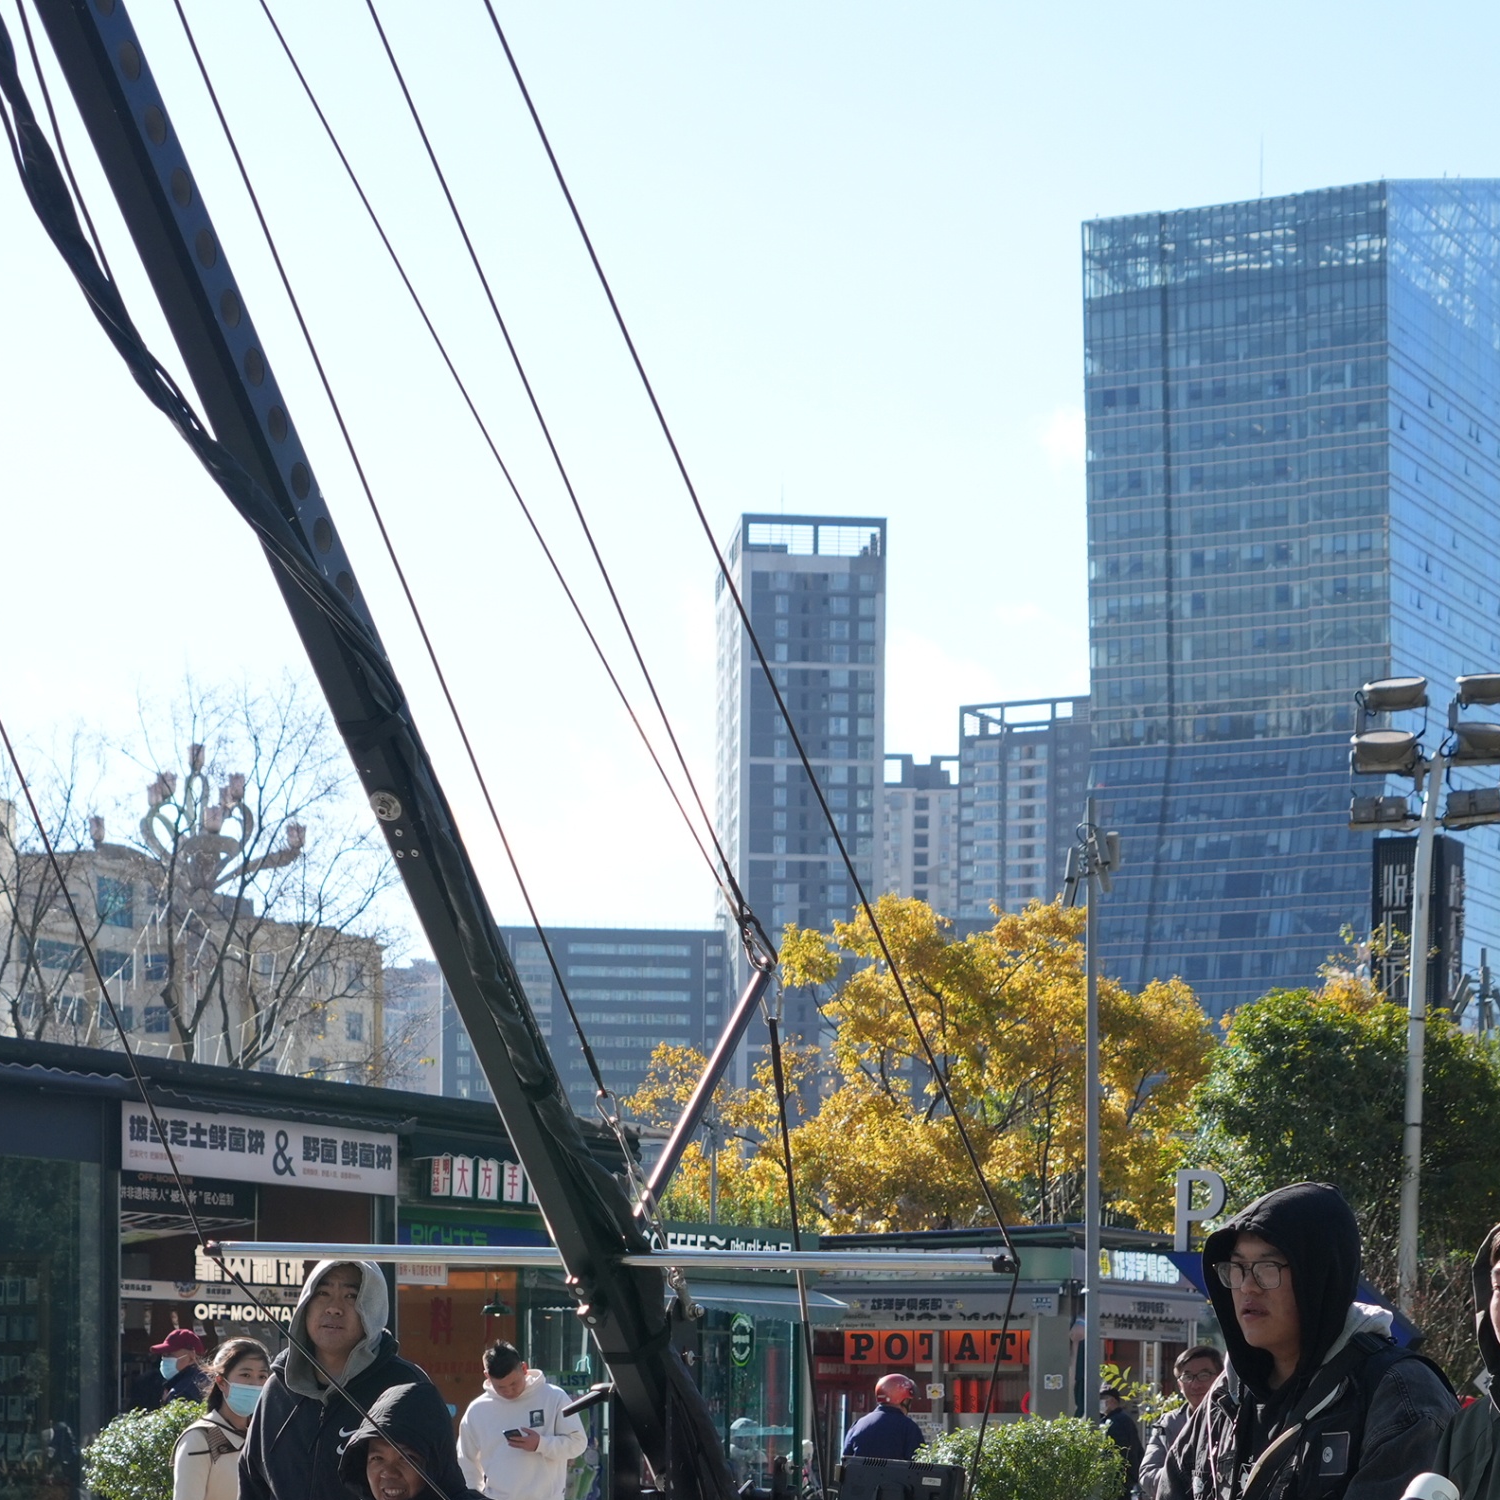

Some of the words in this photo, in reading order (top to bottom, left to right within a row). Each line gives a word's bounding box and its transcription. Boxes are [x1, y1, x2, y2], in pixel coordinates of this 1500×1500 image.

[272, 1130, 296, 1177] &
[457, 1159, 537, 1201] 大方手
[1174, 1169, 1227, 1252] P
[850, 1333, 1031, 1361] POTAT
